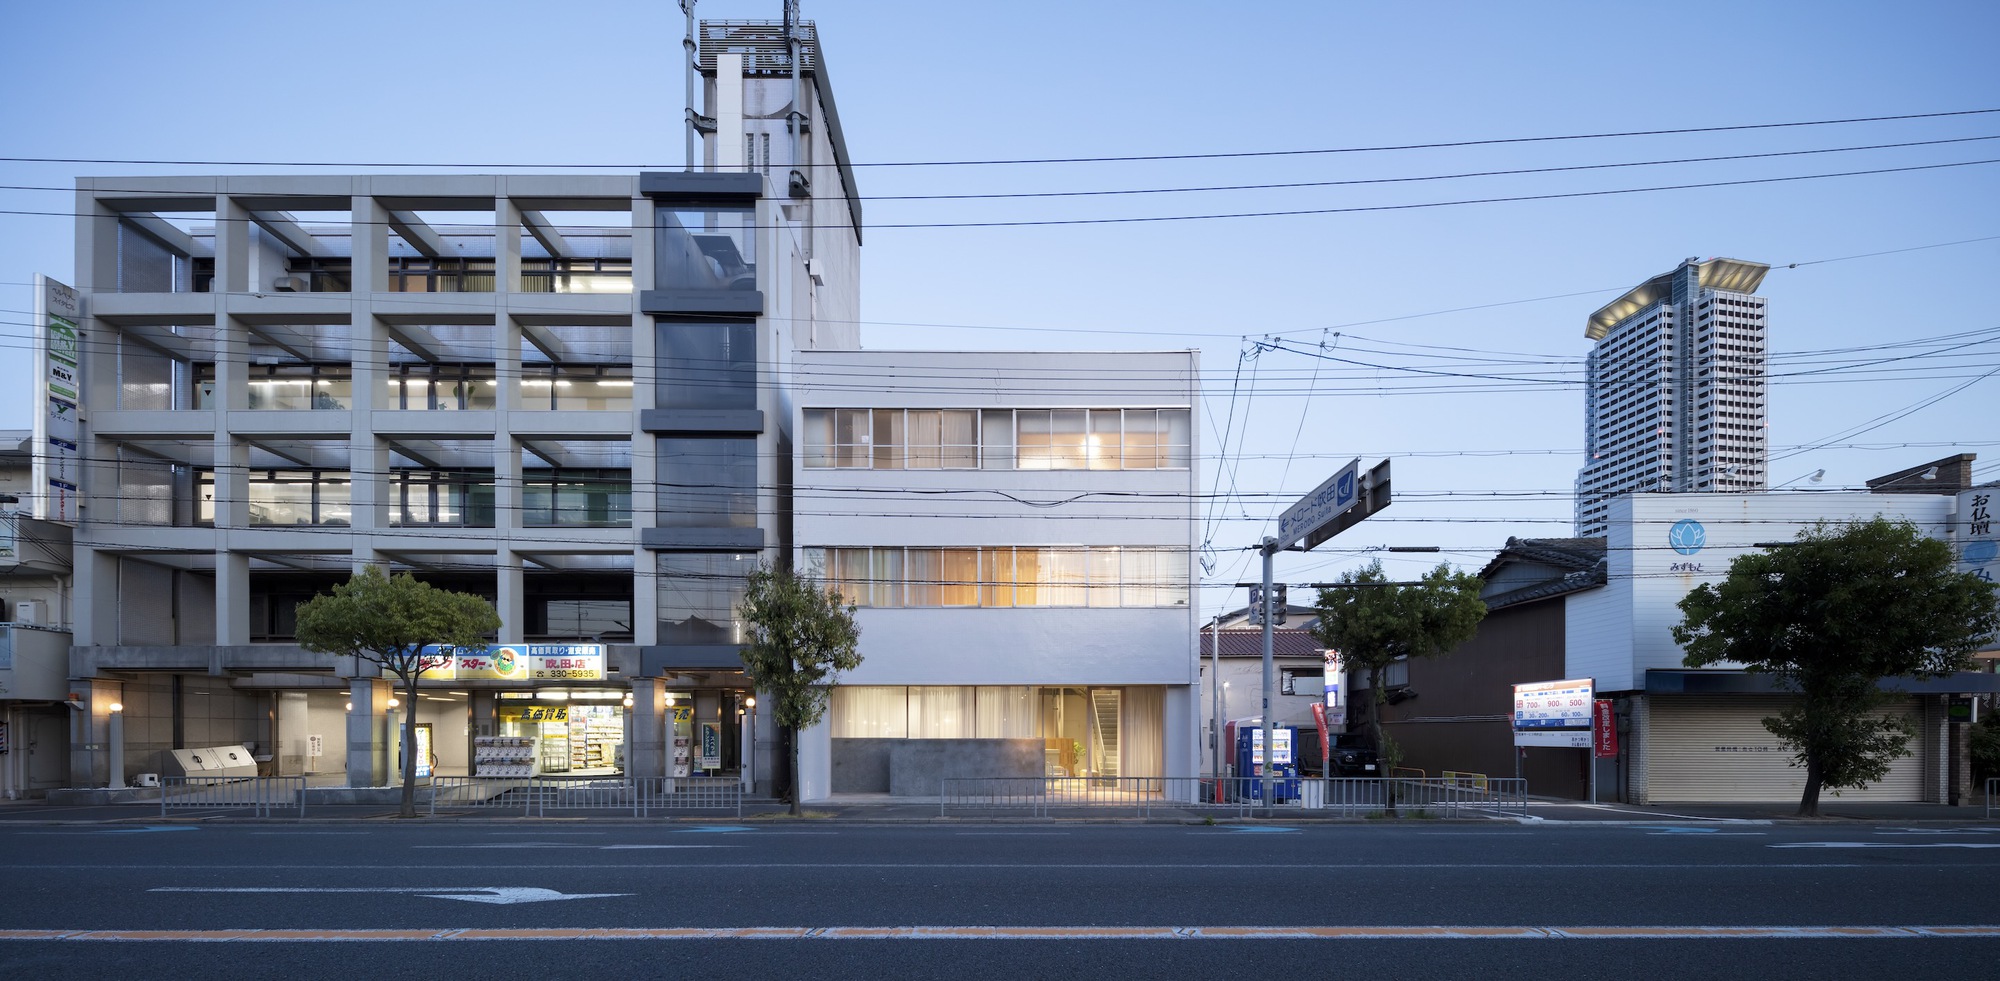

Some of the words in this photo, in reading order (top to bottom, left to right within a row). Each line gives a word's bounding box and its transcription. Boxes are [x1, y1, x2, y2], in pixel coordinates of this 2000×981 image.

[52, 368, 73, 382] M&Y
[57, 440, 68, 448] 2F
[1290, 483, 1336, 528] メロード吹田
[1292, 515, 1316, 536] MERODO
[1317, 505, 1332, 521] Suita
[1970, 494, 1991, 536] お仏壇
[1669, 562, 1705, 572] みずもと
[461, 658, 486, 671] スター
[545, 658, 586, 669] 吹田店
[550, 670, 595, 678] 330-5935
[520, 708, 567, 721] 高価買取
